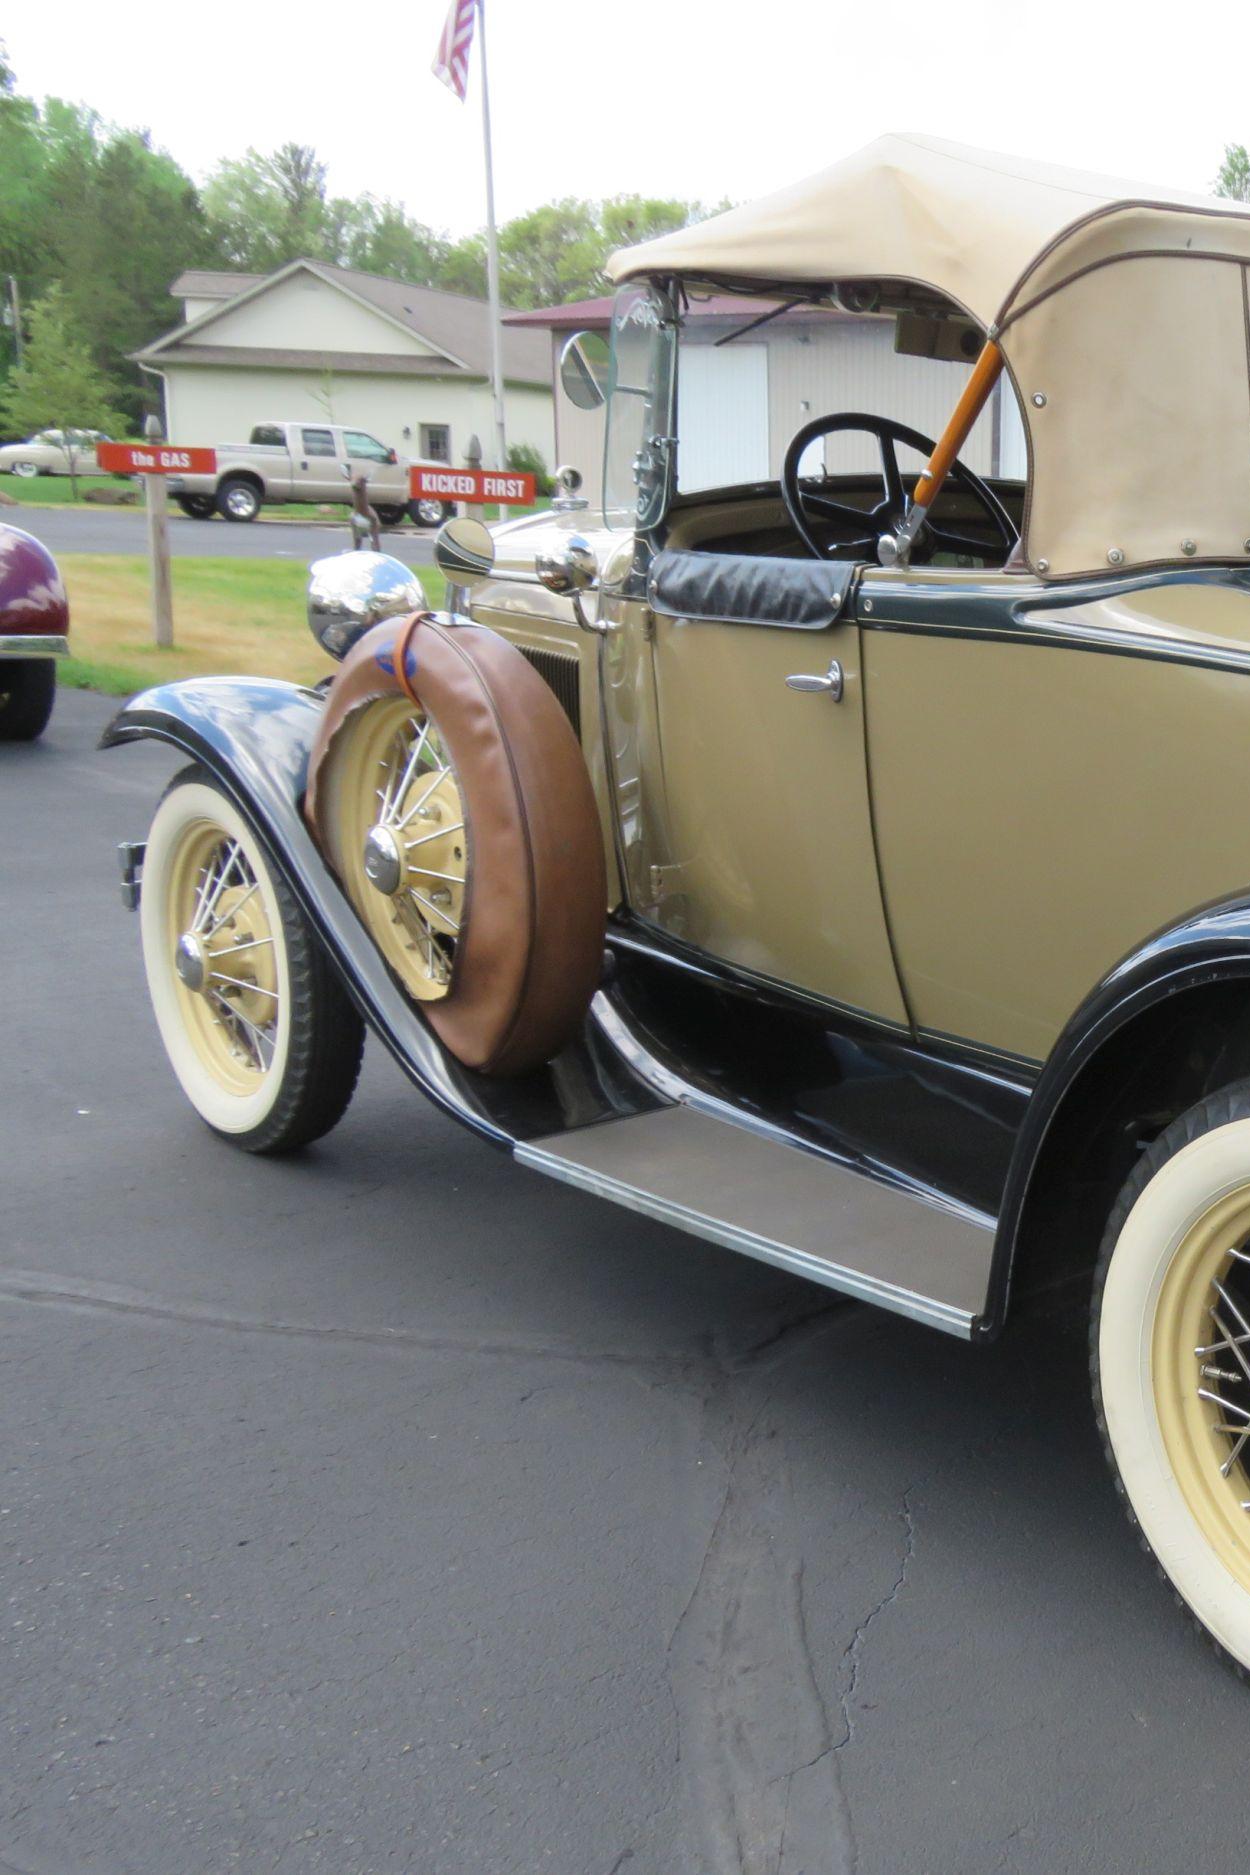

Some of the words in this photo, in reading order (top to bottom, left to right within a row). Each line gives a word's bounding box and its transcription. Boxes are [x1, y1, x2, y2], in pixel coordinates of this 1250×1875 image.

[130, 451, 155, 466] the
[160, 452, 190, 468] GAS
[421, 473, 476, 495] KICKED
[483, 477, 525, 498] FIRST
